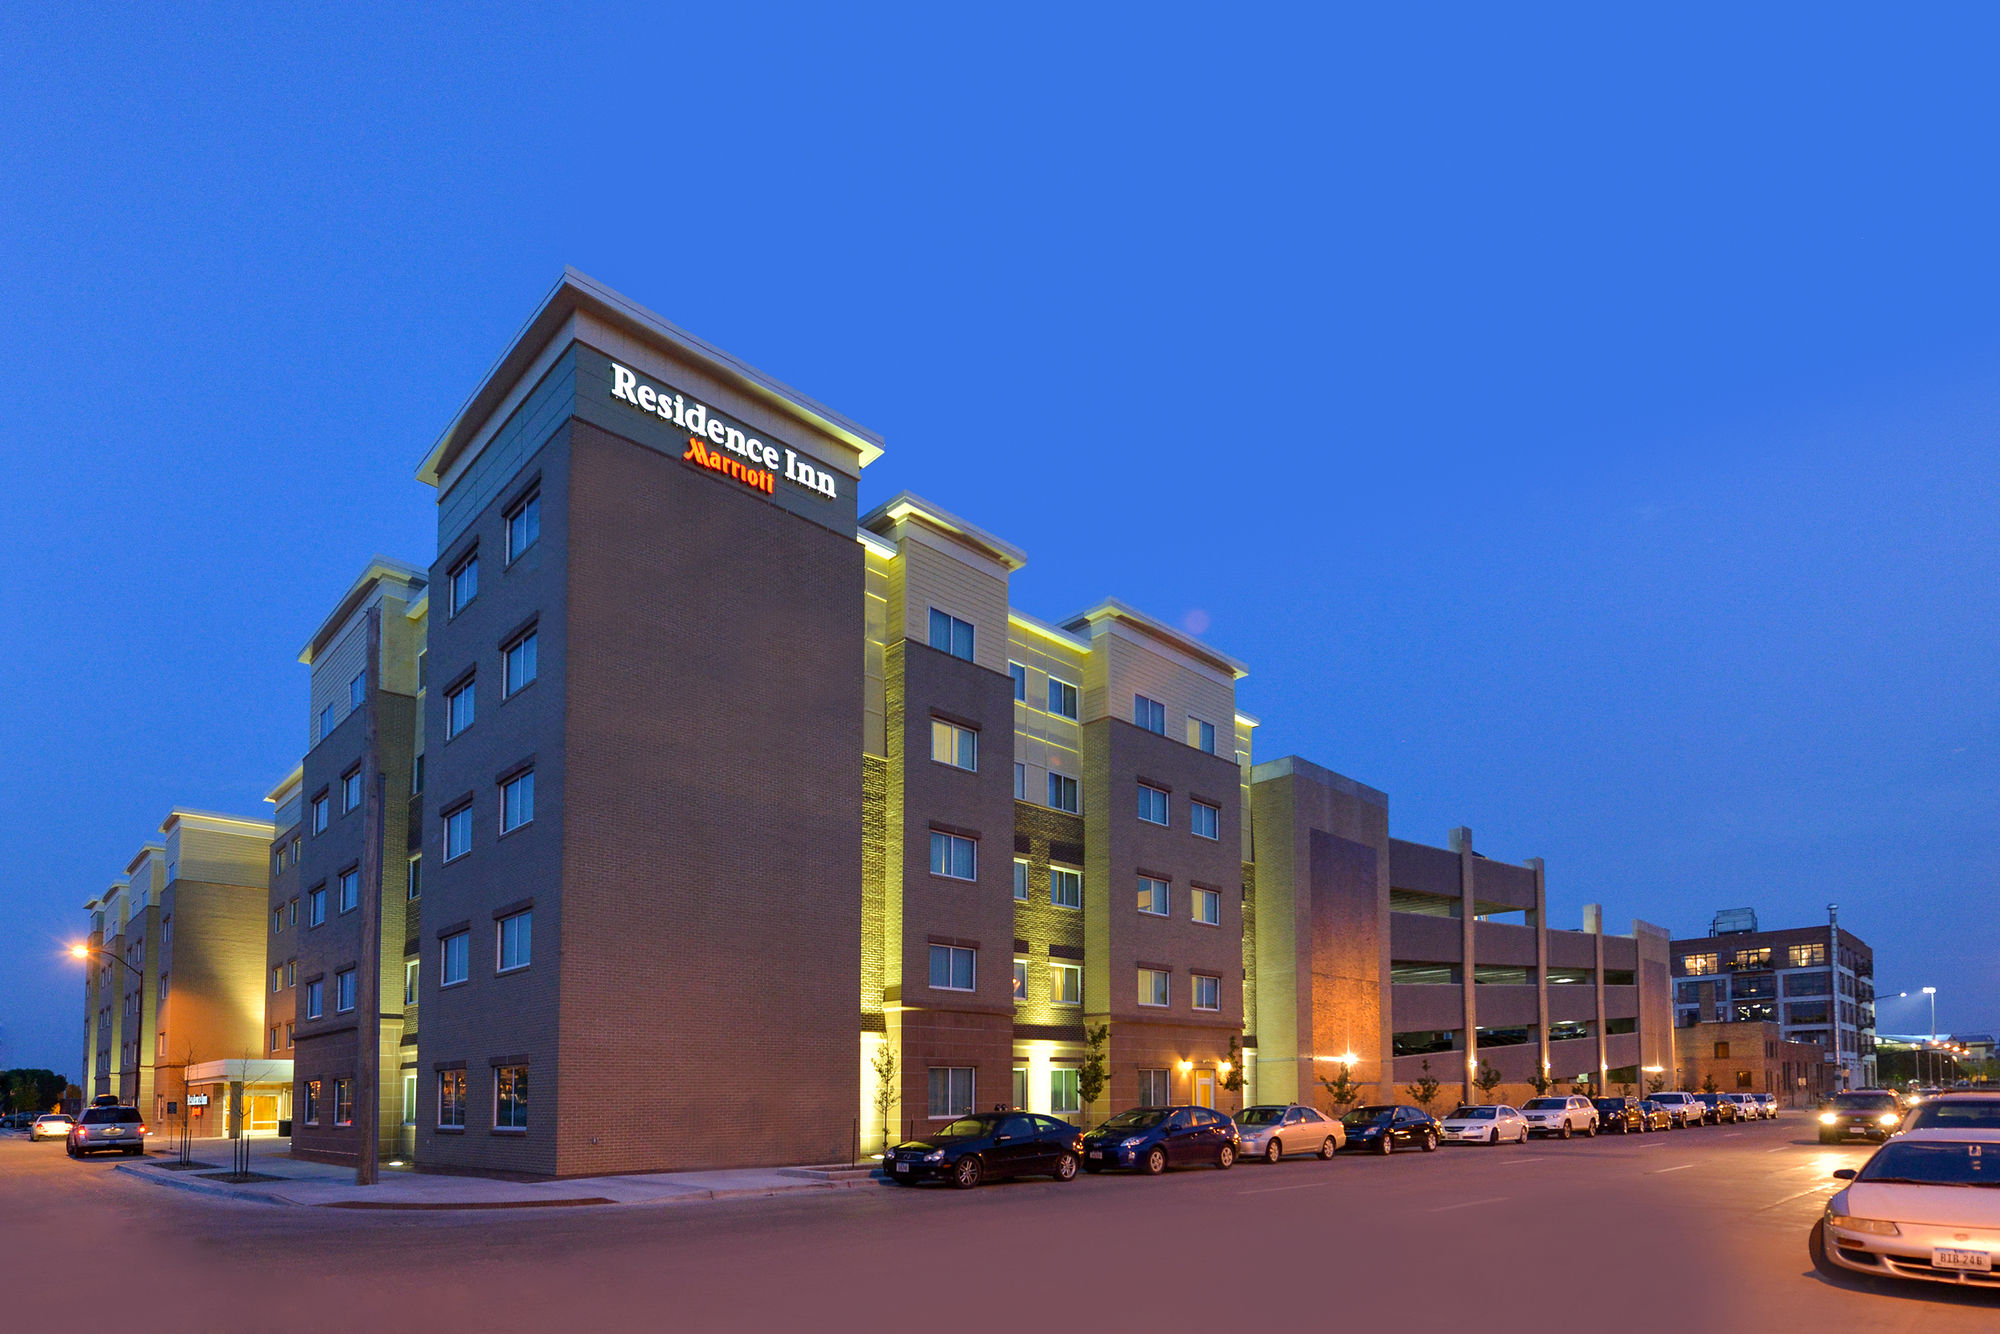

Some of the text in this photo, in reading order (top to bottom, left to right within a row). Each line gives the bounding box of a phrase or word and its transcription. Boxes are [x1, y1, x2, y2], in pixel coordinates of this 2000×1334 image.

[611, 362, 837, 498] Residence Inn
[683, 437, 775, 494] Marriott
